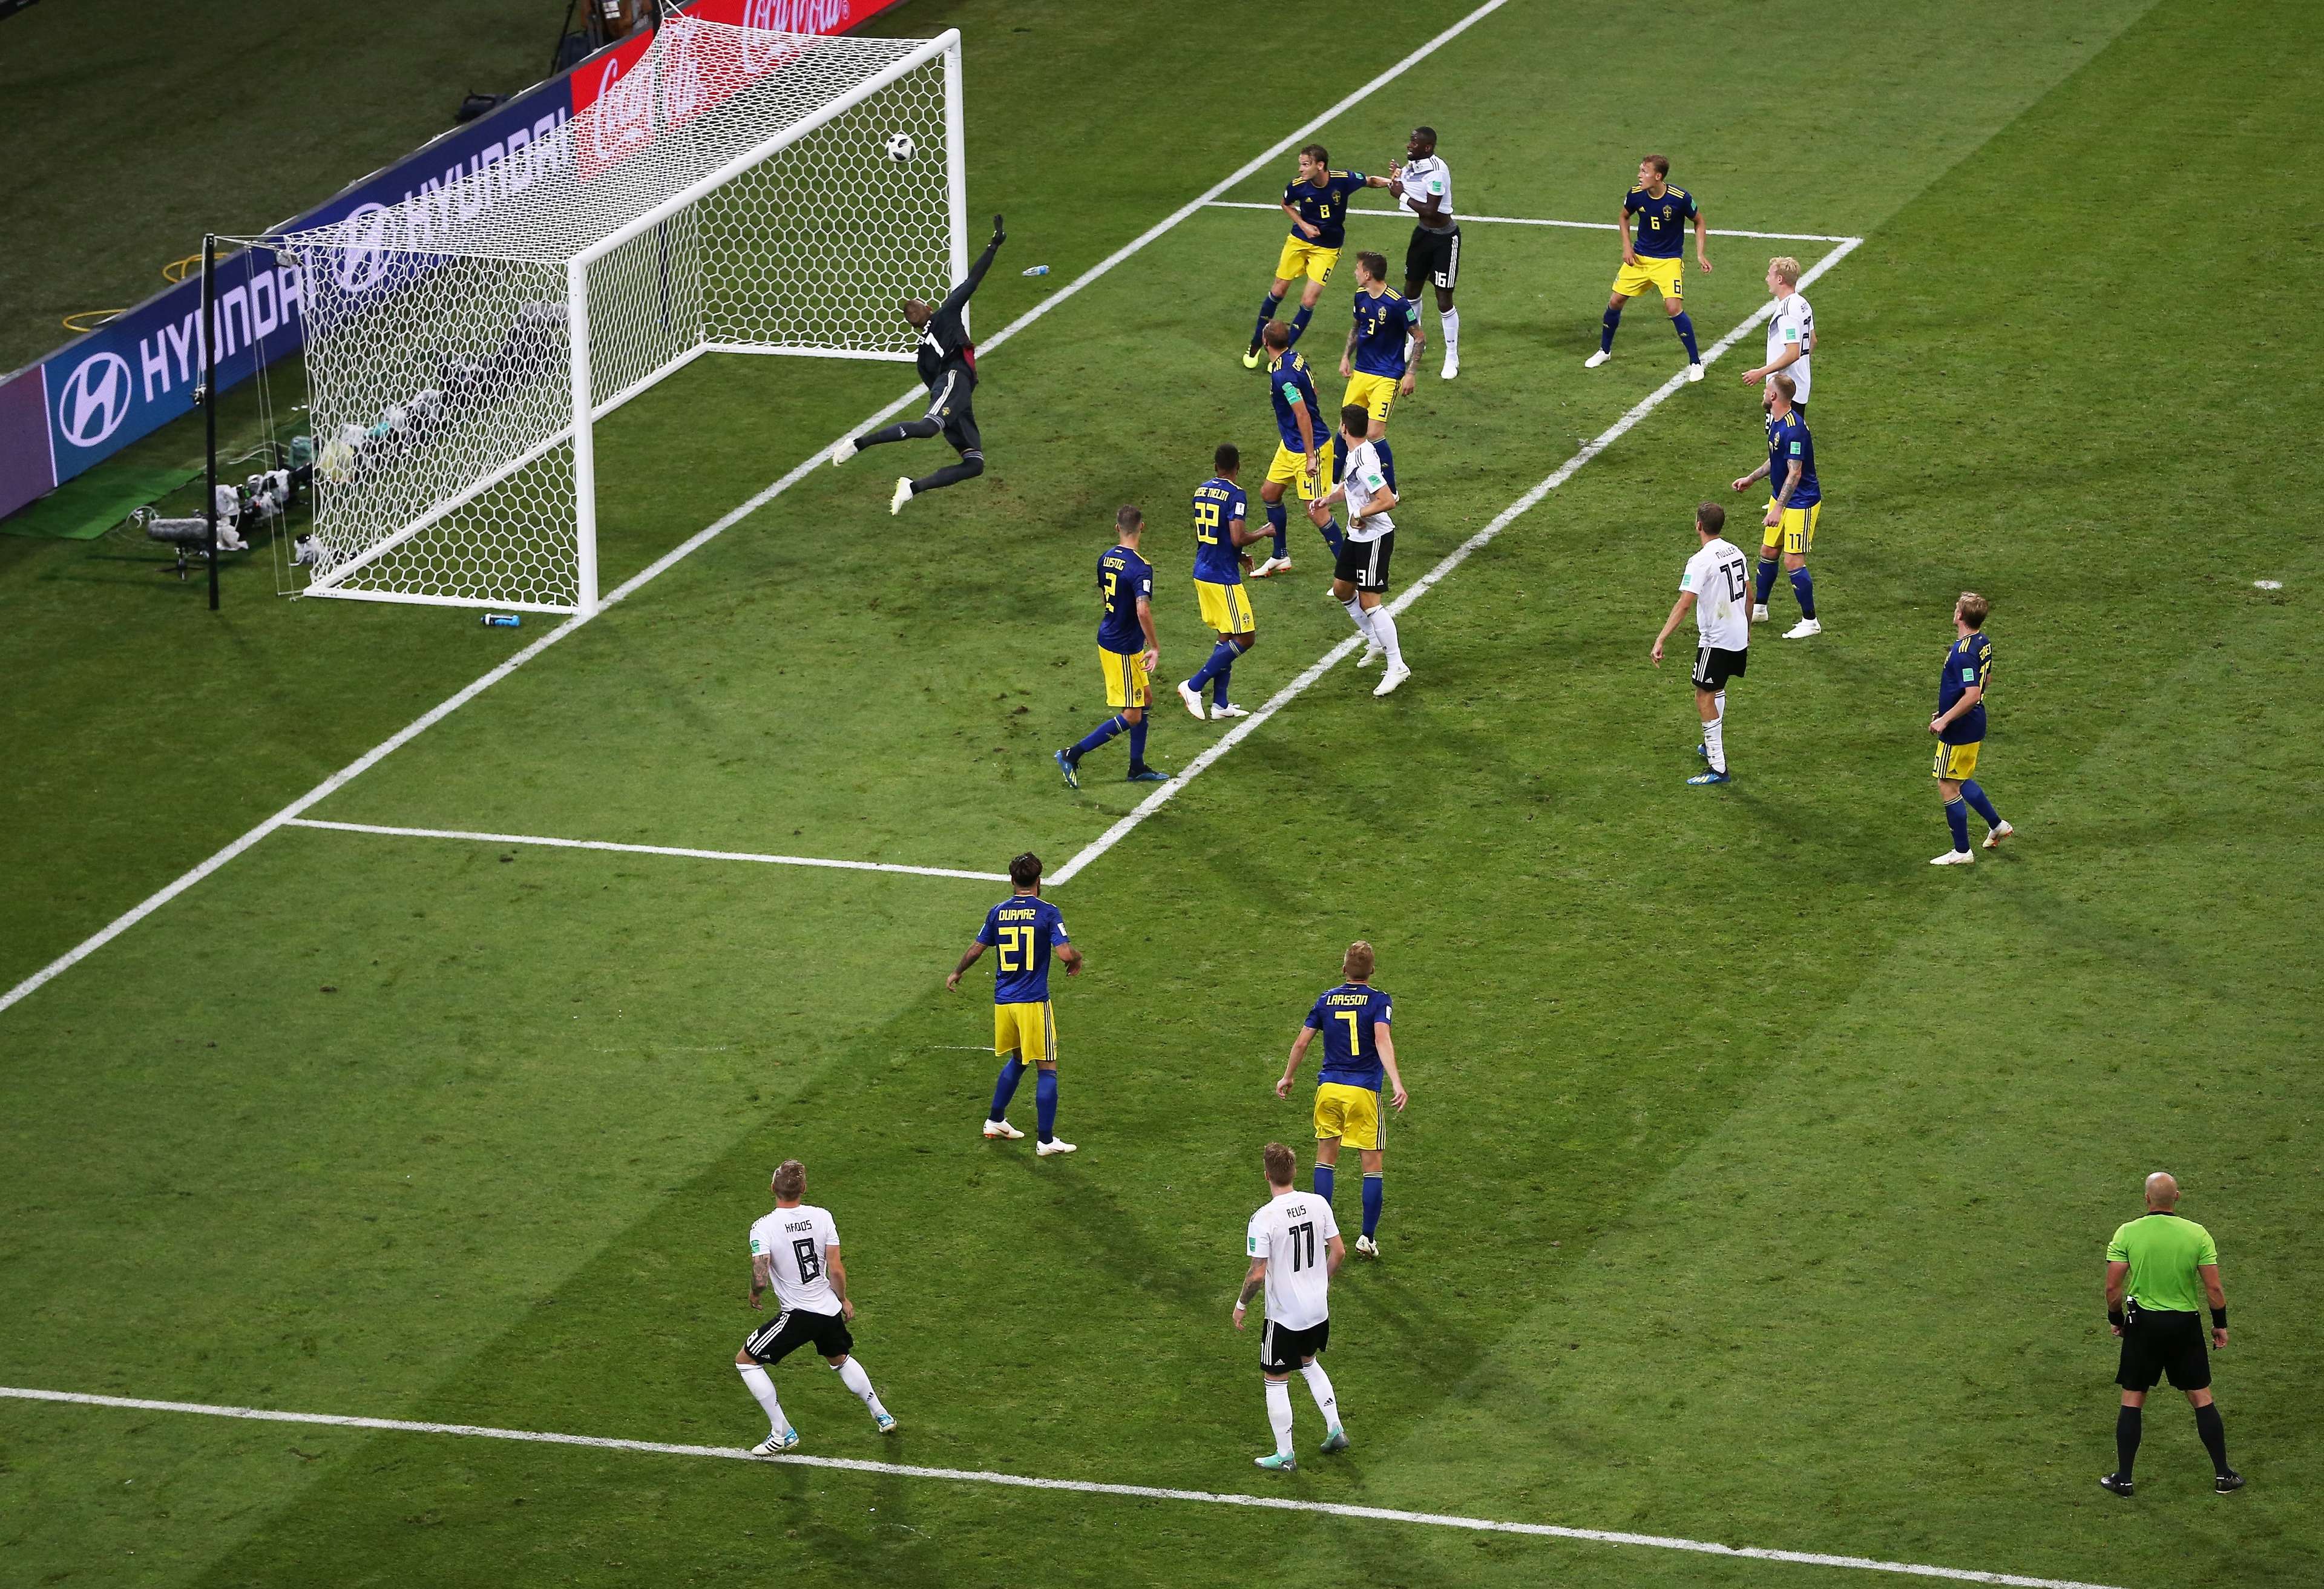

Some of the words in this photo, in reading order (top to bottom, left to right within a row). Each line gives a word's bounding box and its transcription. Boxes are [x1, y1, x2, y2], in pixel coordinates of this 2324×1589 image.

[1320, 205, 1330, 219] 8
[1650, 217, 1660, 230] 6
[1321, 267, 1331, 283] 8
[1434, 270, 1447, 288] 16
[1673, 279, 1681, 294] 6
[1367, 318, 1376, 335] 3
[1378, 402, 1388, 418] 3
[1303, 481, 1312, 495] 4
[1195, 502, 1220, 545] 22
[1788, 533, 1802, 550] 11
[1103, 556, 1126, 571] LUSTIG
[1356, 569, 1366, 586] 3
[1719, 558, 1746, 603] 13
[1103, 572, 1117, 613] 2
[999, 909, 1036, 921] DURMAZ
[998, 926, 1035, 972] 21
[1326, 994, 1368, 1006] LARSSON
[1334, 1010, 1360, 1056] 7
[1286, 1205, 1307, 1219] REUS
[784, 1220, 812, 1233] KROOS
[1288, 1221, 1315, 1272] 11
[792, 1237, 821, 1285] 8
